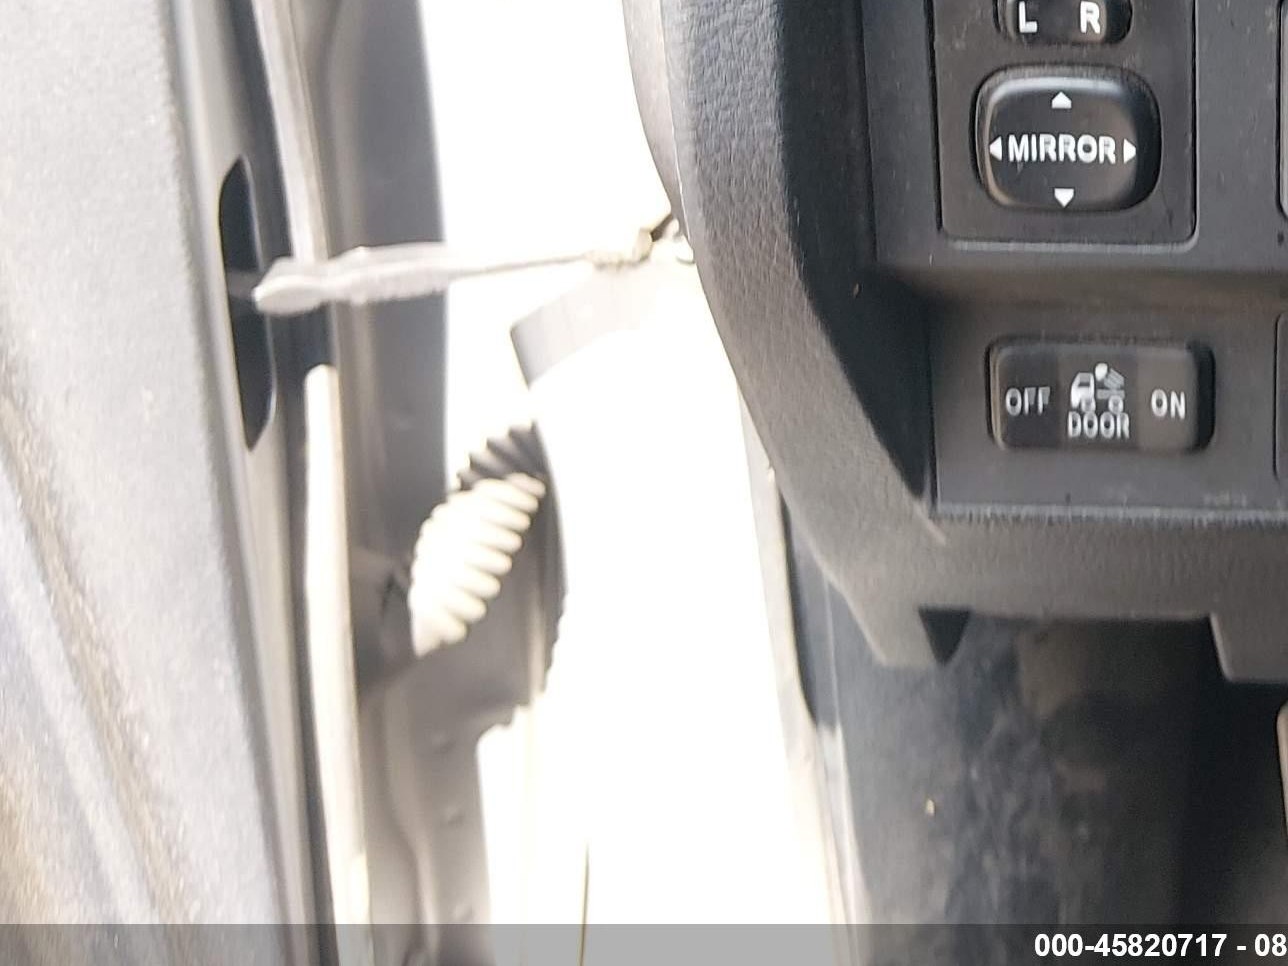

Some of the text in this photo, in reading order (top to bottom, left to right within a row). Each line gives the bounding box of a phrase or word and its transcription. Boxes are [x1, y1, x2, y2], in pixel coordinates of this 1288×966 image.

[1018, 0, 1101, 34] L R
[1008, 133, 1116, 164] MIRROR
[1005, 386, 1186, 420] OFF ON
[1068, 411, 1130, 439] DOOR
